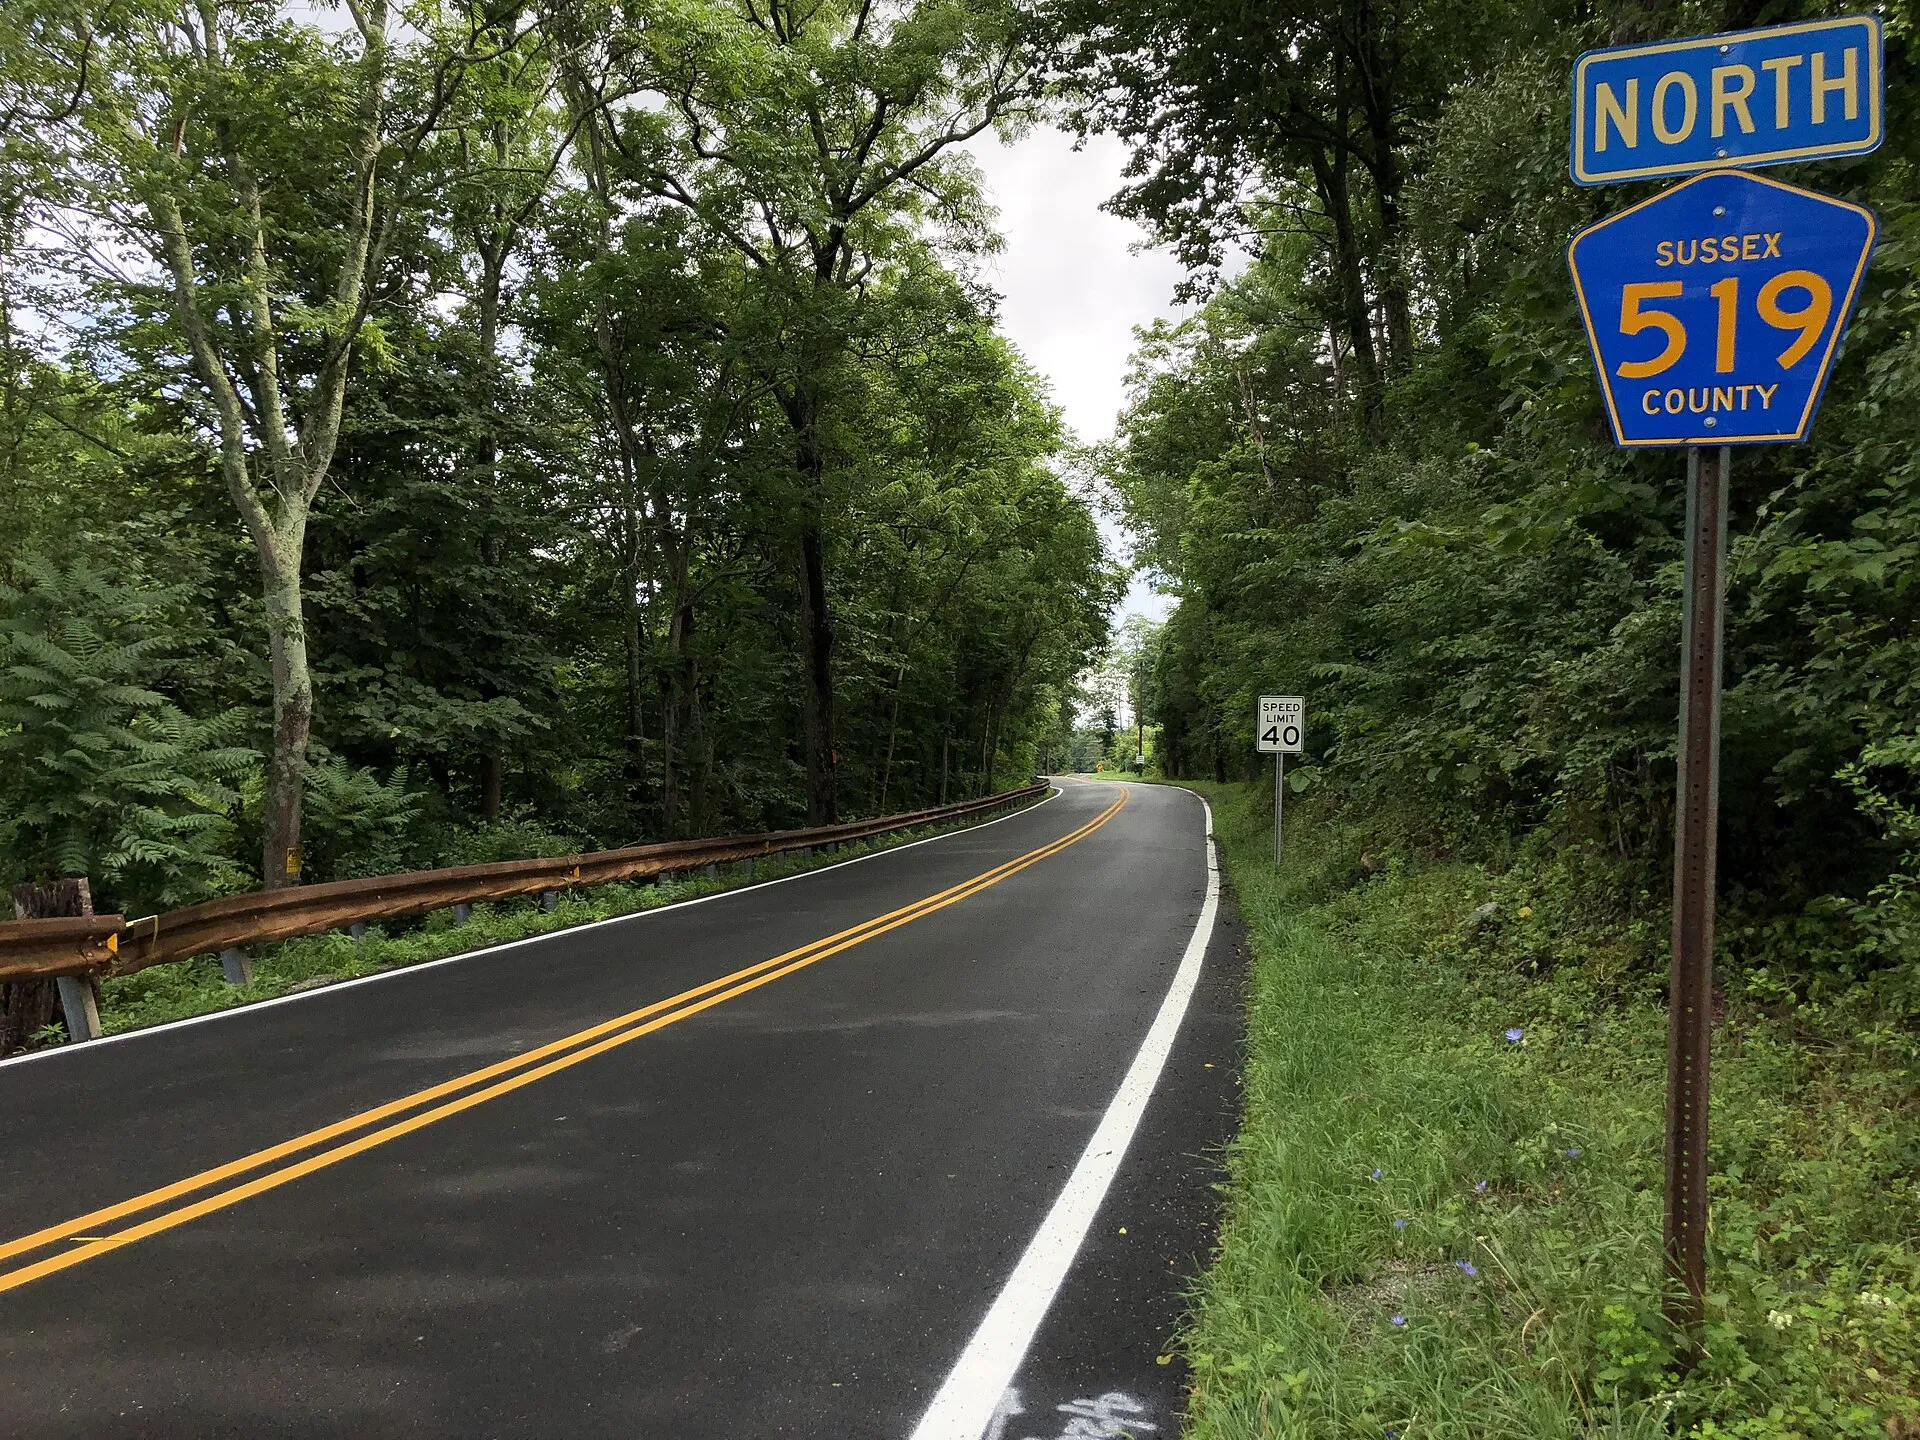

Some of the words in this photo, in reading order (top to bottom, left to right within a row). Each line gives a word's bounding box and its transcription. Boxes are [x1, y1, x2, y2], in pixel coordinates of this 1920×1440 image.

[1595, 47, 1858, 152] NORTH
[1656, 232, 1782, 267] SUSSEX
[1616, 270, 1833, 379] 519
[1643, 384, 1779, 415] COUNTY
[1263, 703, 1300, 712] SPEED
[1266, 714, 1296, 723] LIMIT
[1261, 725, 1300, 746] 40
